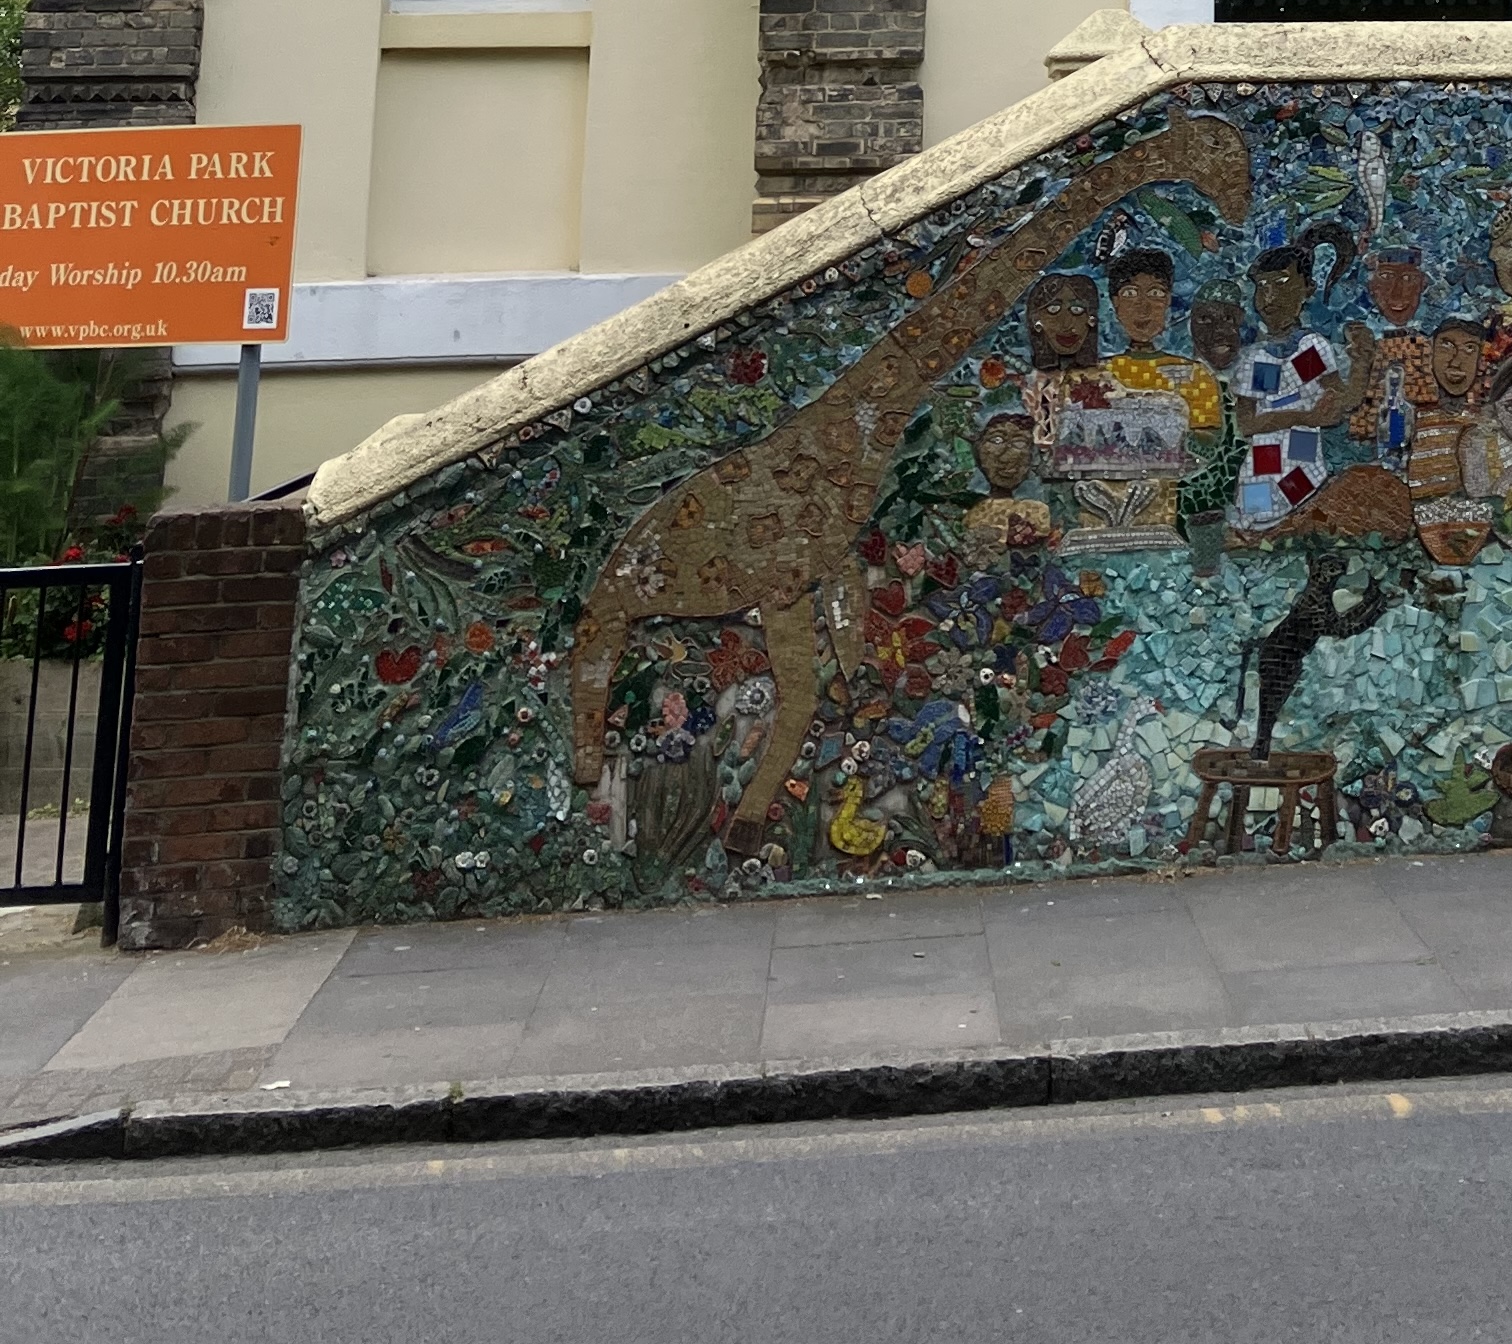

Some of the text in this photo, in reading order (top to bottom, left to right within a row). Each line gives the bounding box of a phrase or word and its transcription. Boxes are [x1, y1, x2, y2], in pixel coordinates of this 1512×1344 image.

[22, 151, 275, 184] VICTORIA PARK
[1, 197, 285, 229] BAPTIST CHURCH
[50, 261, 142, 289] Worship
[152, 261, 247, 284] 10.30am
[20, 320, 168, 340] www.vpbc.org.uk
